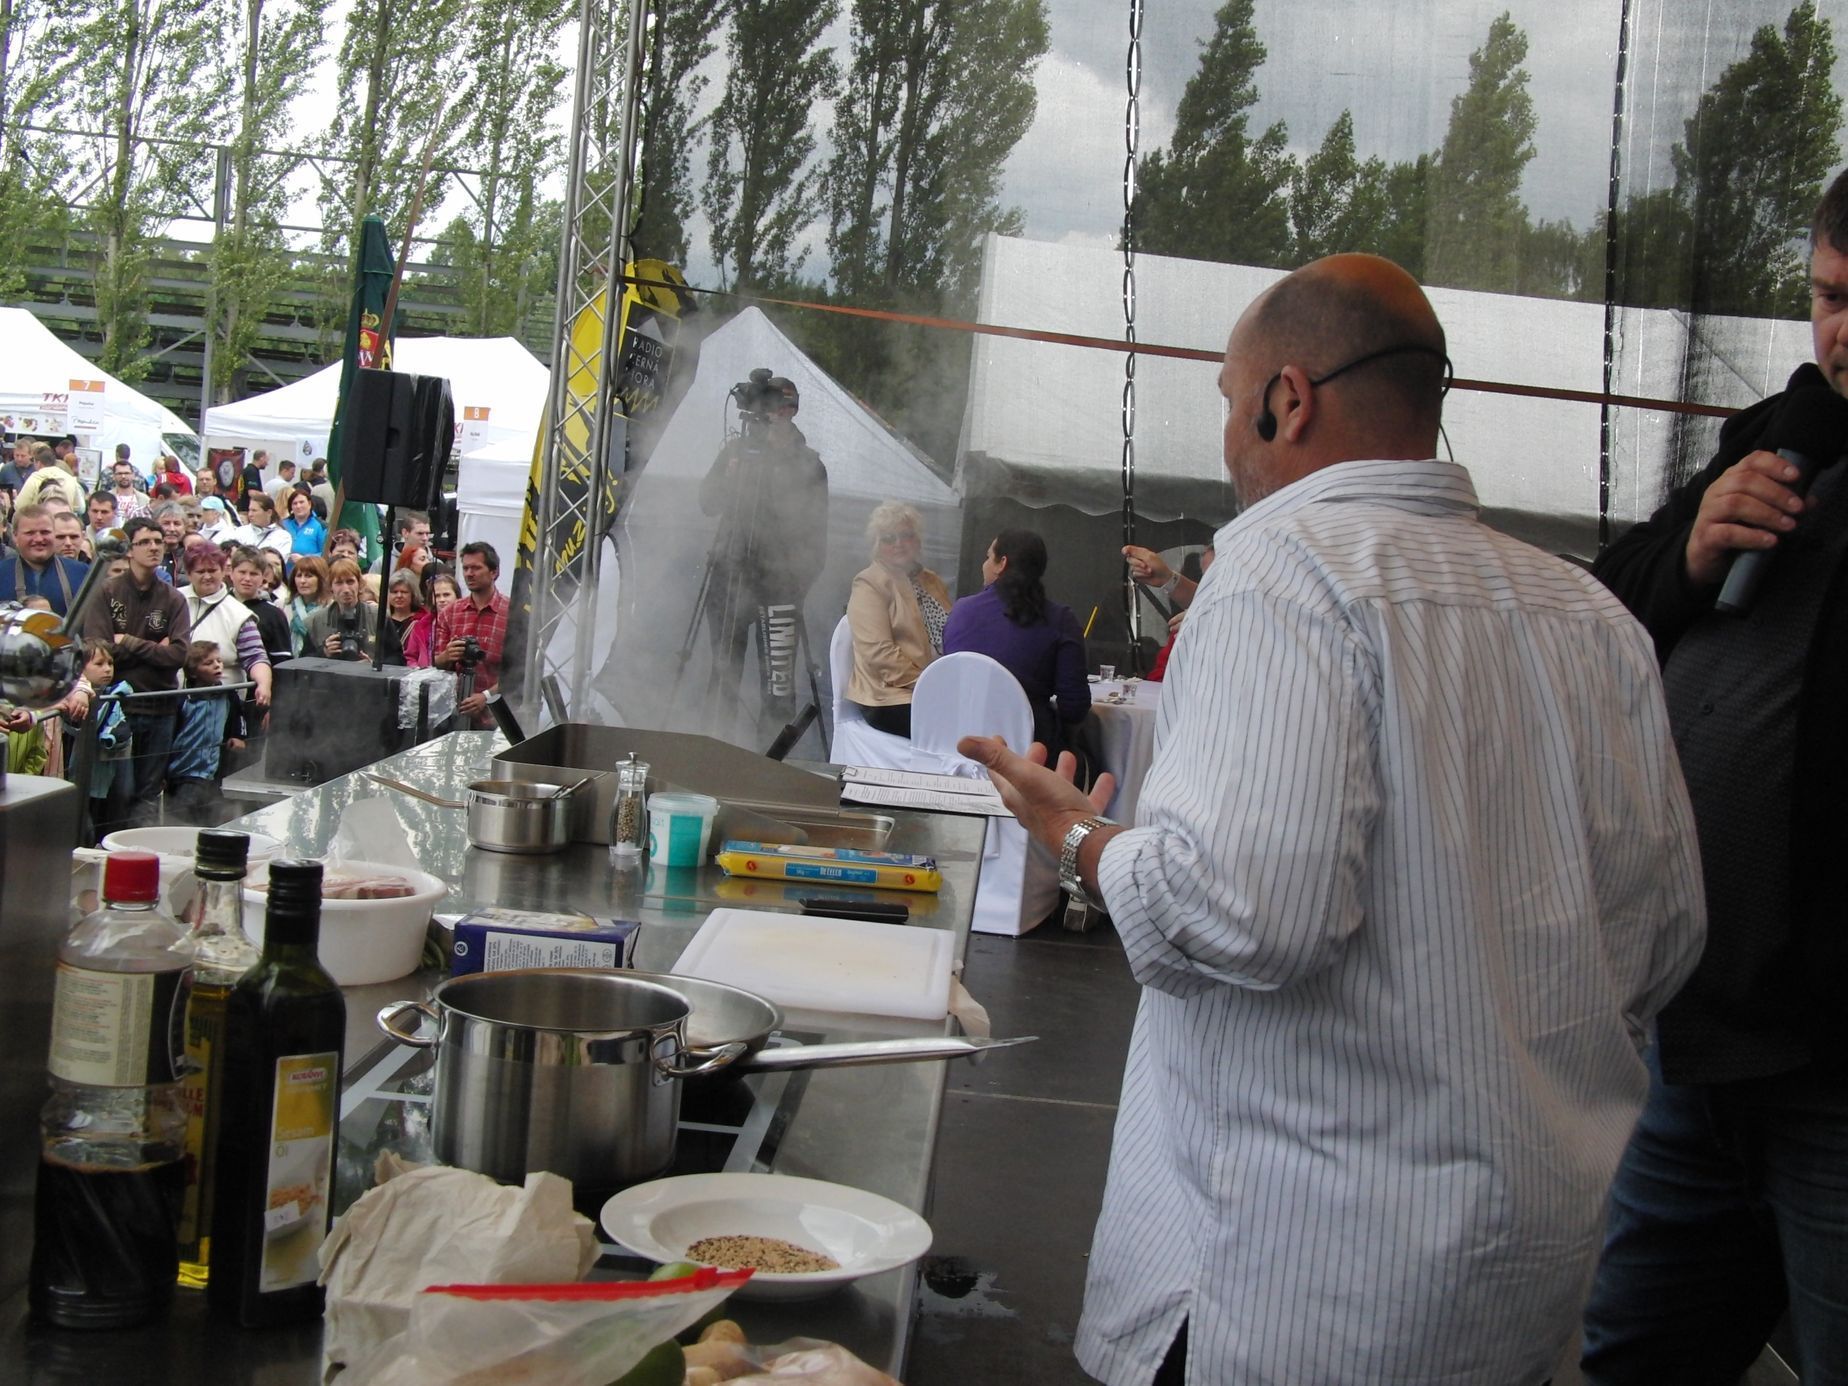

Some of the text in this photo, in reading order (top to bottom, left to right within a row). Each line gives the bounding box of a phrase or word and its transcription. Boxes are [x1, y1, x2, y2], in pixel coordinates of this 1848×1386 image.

[83, 381, 91, 391] 7
[474, 407, 480, 419] 8
[767, 604, 796, 697] LIMITED
